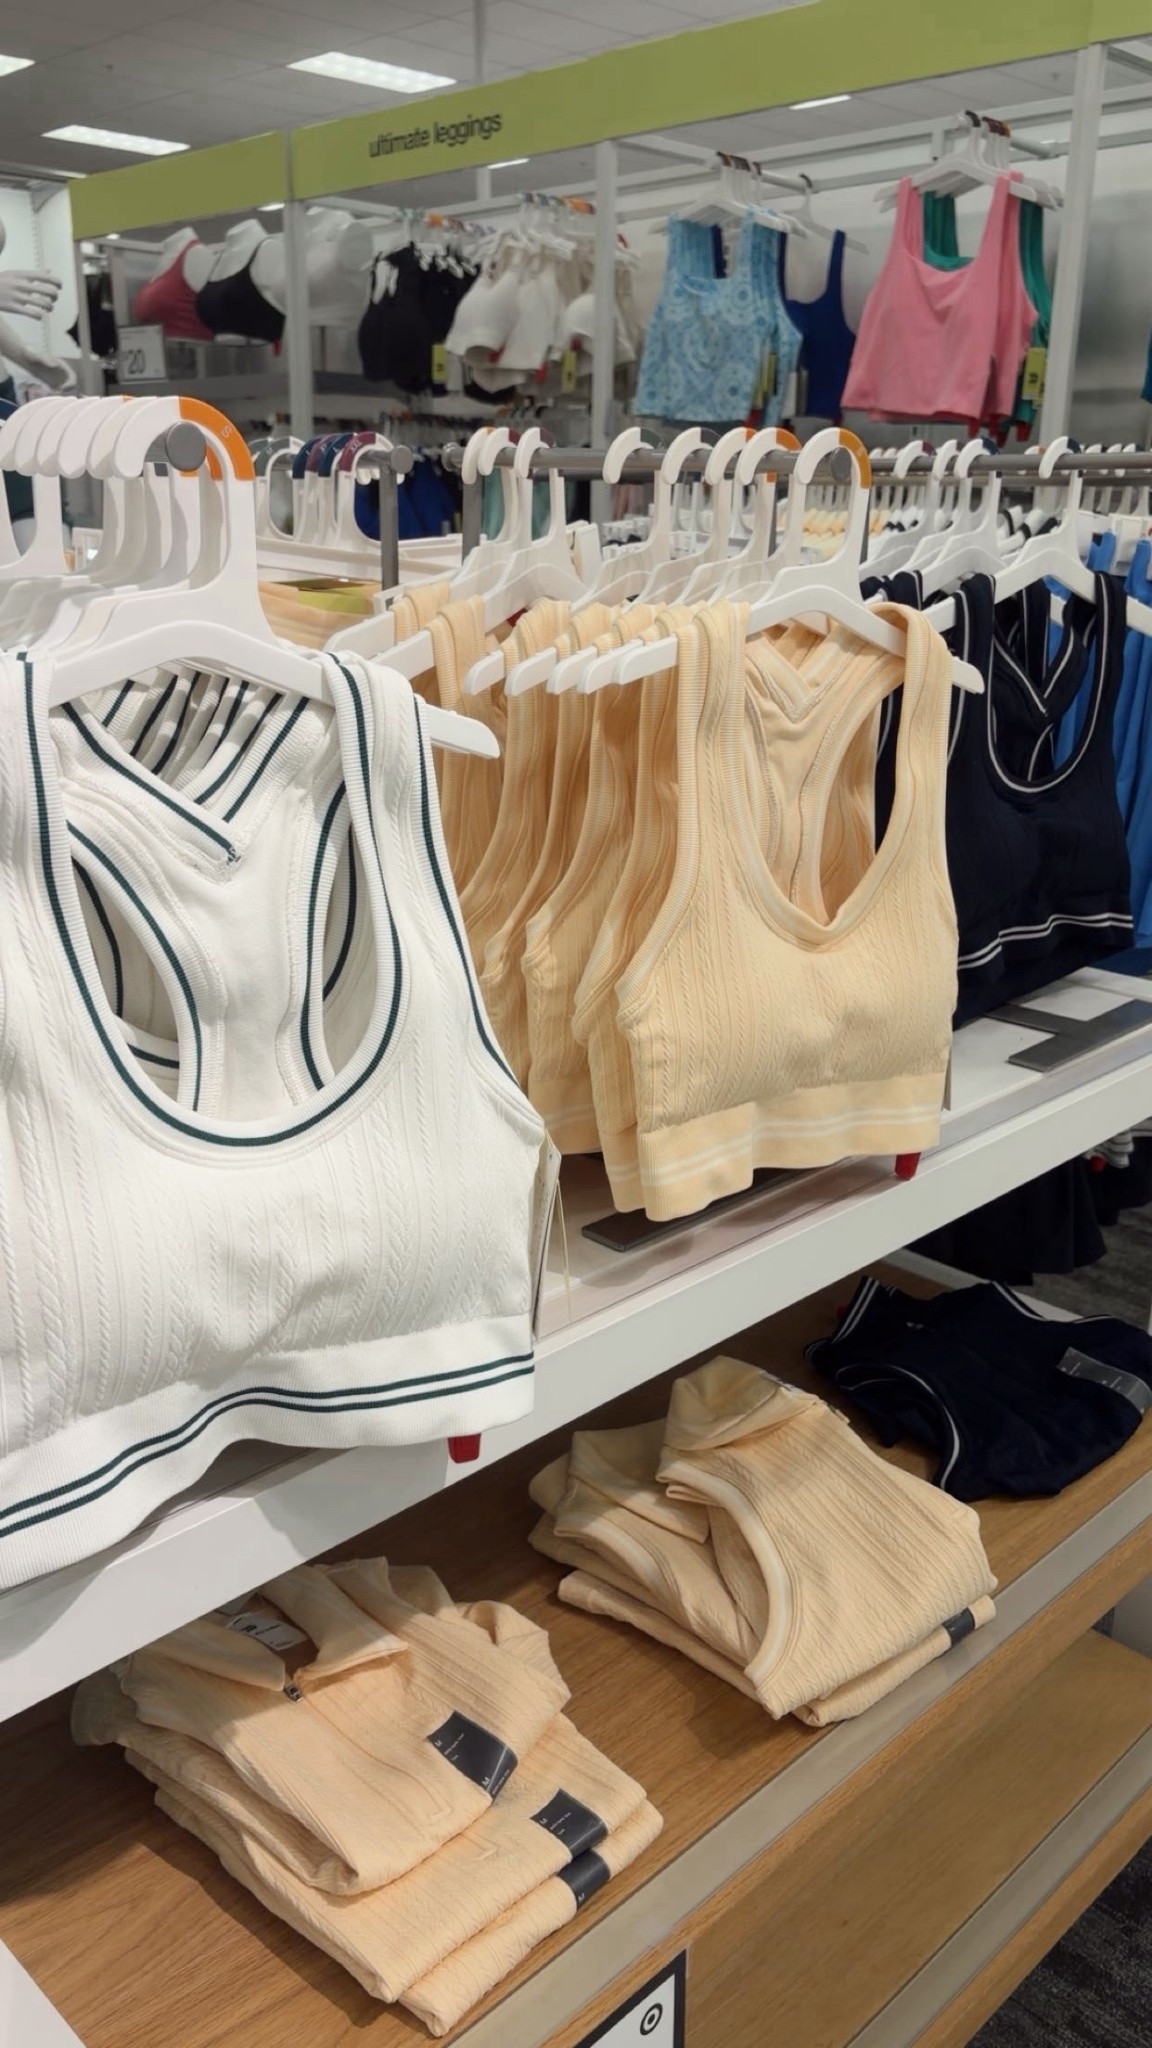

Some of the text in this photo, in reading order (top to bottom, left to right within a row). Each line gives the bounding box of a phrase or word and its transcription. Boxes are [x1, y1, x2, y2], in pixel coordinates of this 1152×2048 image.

[369, 114, 503, 158] ultimate leggings
[222, 425, 234, 438] S
[481, 1776, 491, 1786] M
